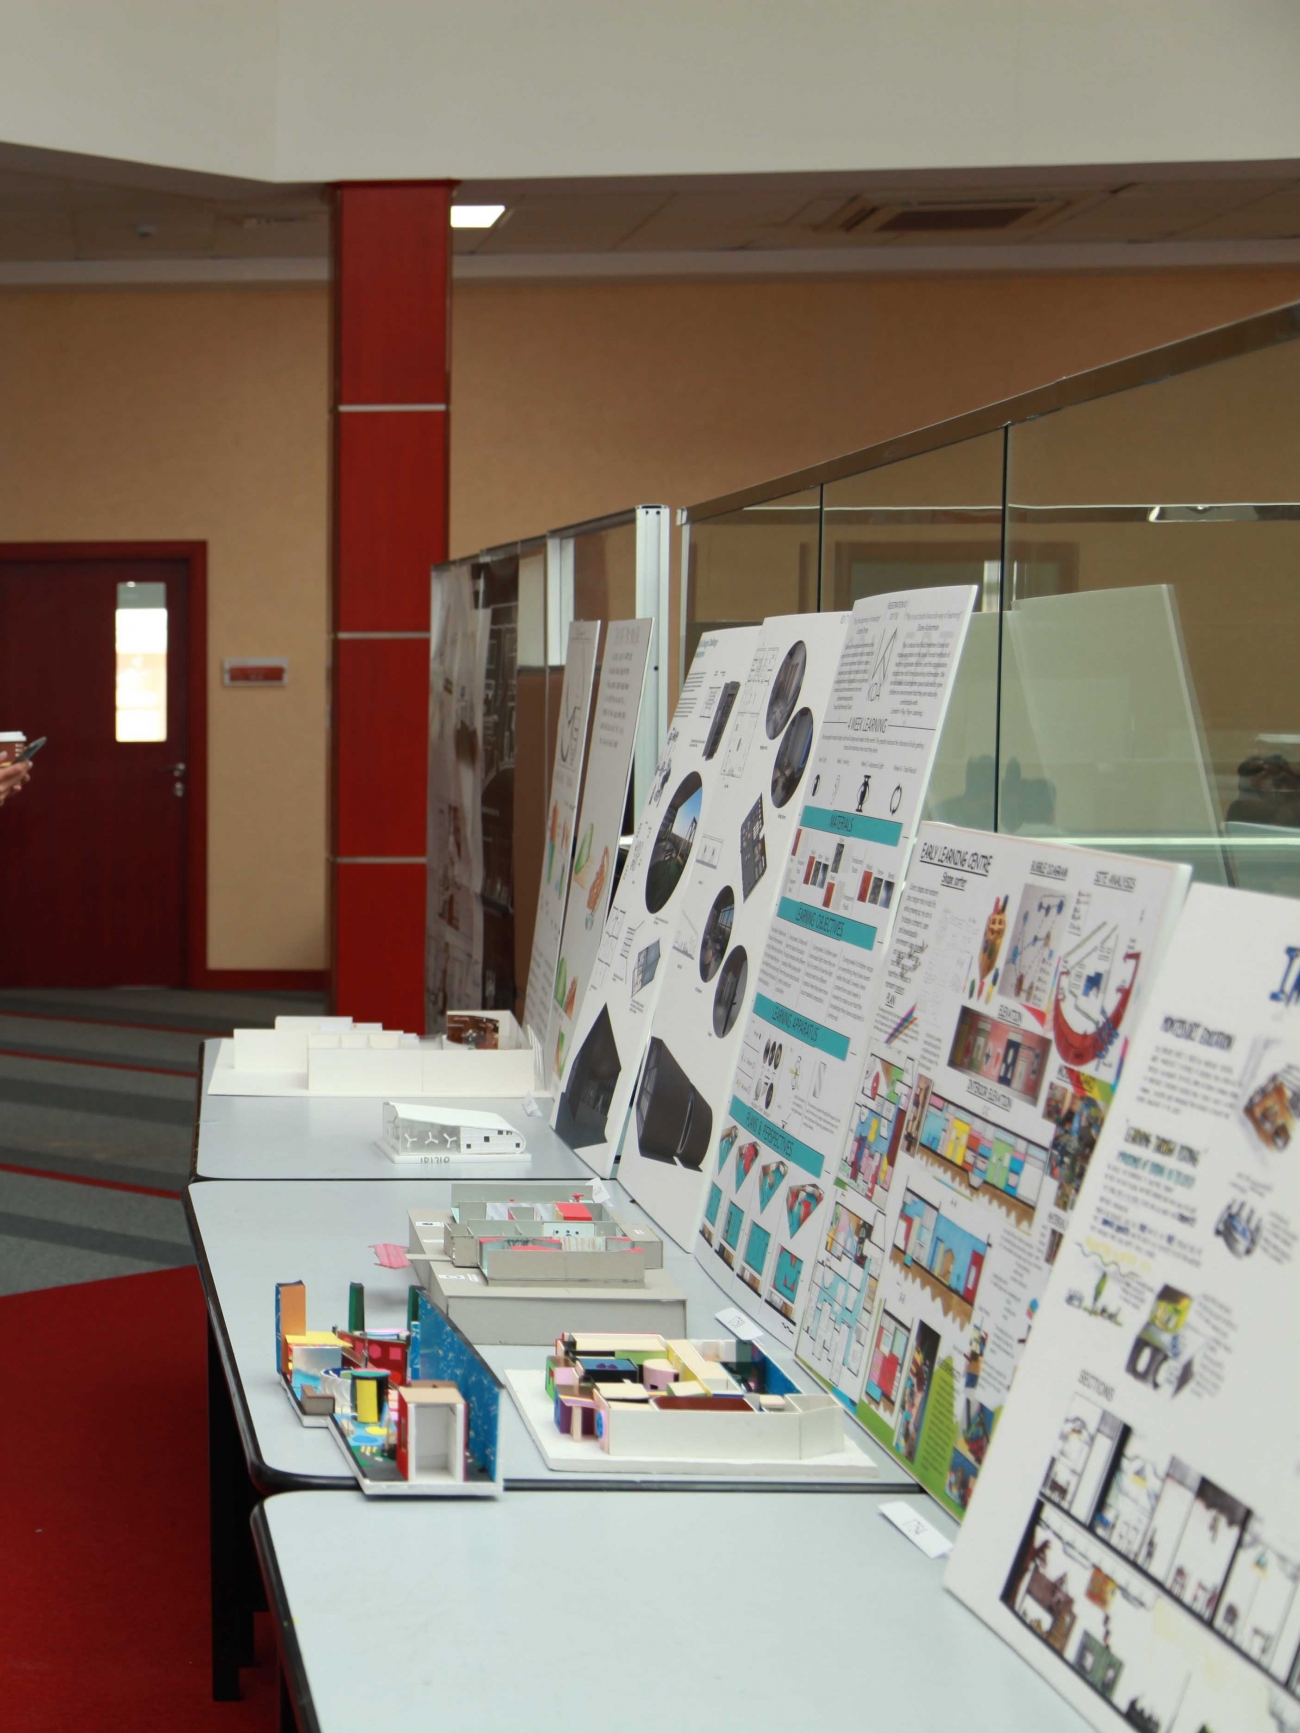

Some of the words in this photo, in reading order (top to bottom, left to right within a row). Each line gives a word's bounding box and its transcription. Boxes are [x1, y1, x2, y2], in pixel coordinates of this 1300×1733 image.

[863, 717, 888, 733] LEARNING
[920, 842, 939, 860] EARLY
[938, 846, 968, 867] LEARNING
[967, 852, 993, 873] CENTRE
[1079, 1369, 1115, 1402] SECTIONS
